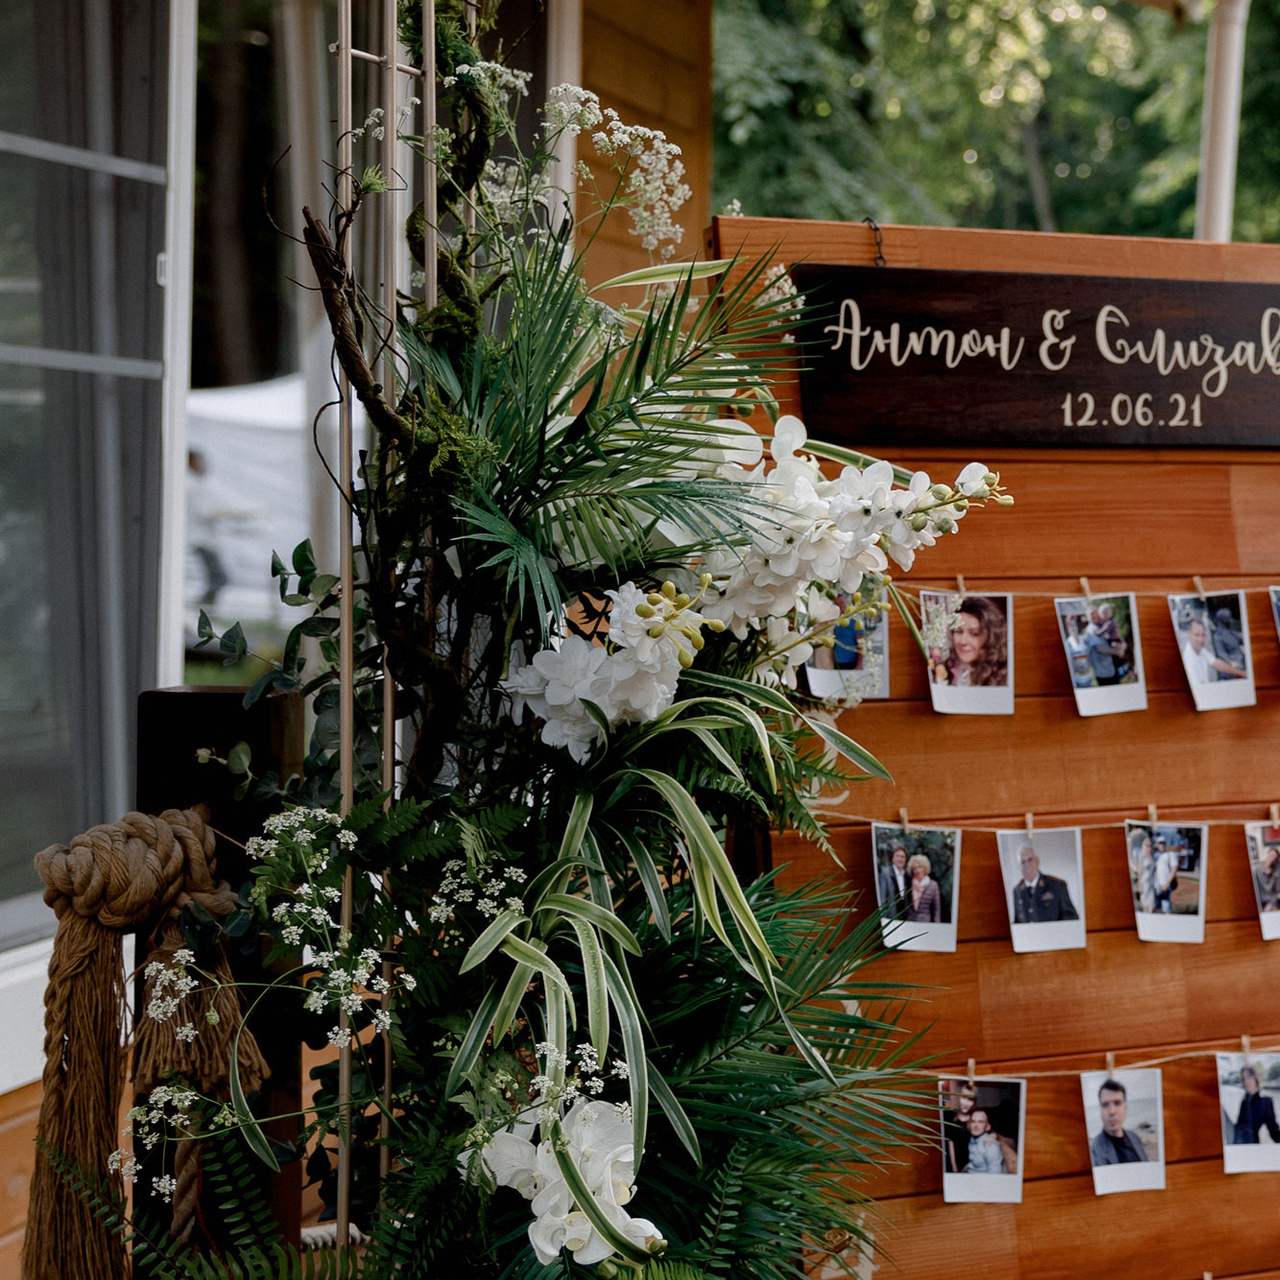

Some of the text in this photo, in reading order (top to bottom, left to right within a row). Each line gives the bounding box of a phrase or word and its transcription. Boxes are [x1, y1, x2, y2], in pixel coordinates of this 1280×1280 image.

[824, 299, 1025, 370] Антон
[1039, 309, 1076, 371] &
[1062, 392, 1202, 427] 12.06.21
